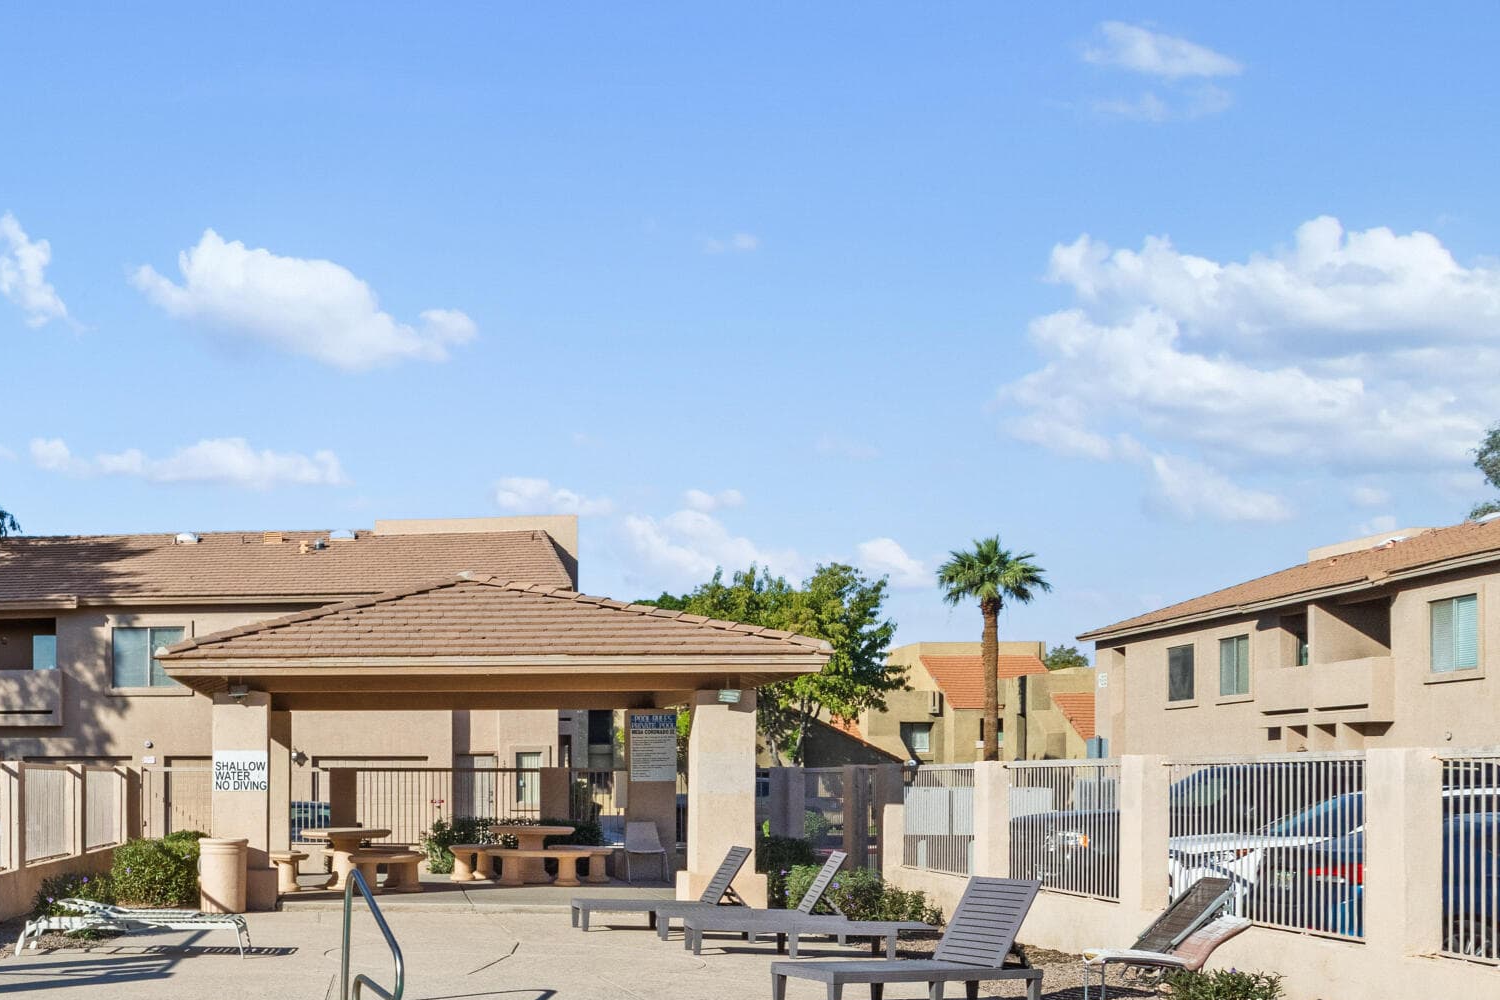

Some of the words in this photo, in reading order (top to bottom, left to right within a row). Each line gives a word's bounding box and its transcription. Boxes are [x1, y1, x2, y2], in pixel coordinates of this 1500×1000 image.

[215, 761, 266, 771] SHALLOW
[215, 771, 251, 780] WATER
[215, 781, 230, 790] NO
[233, 781, 267, 790] DIVING
